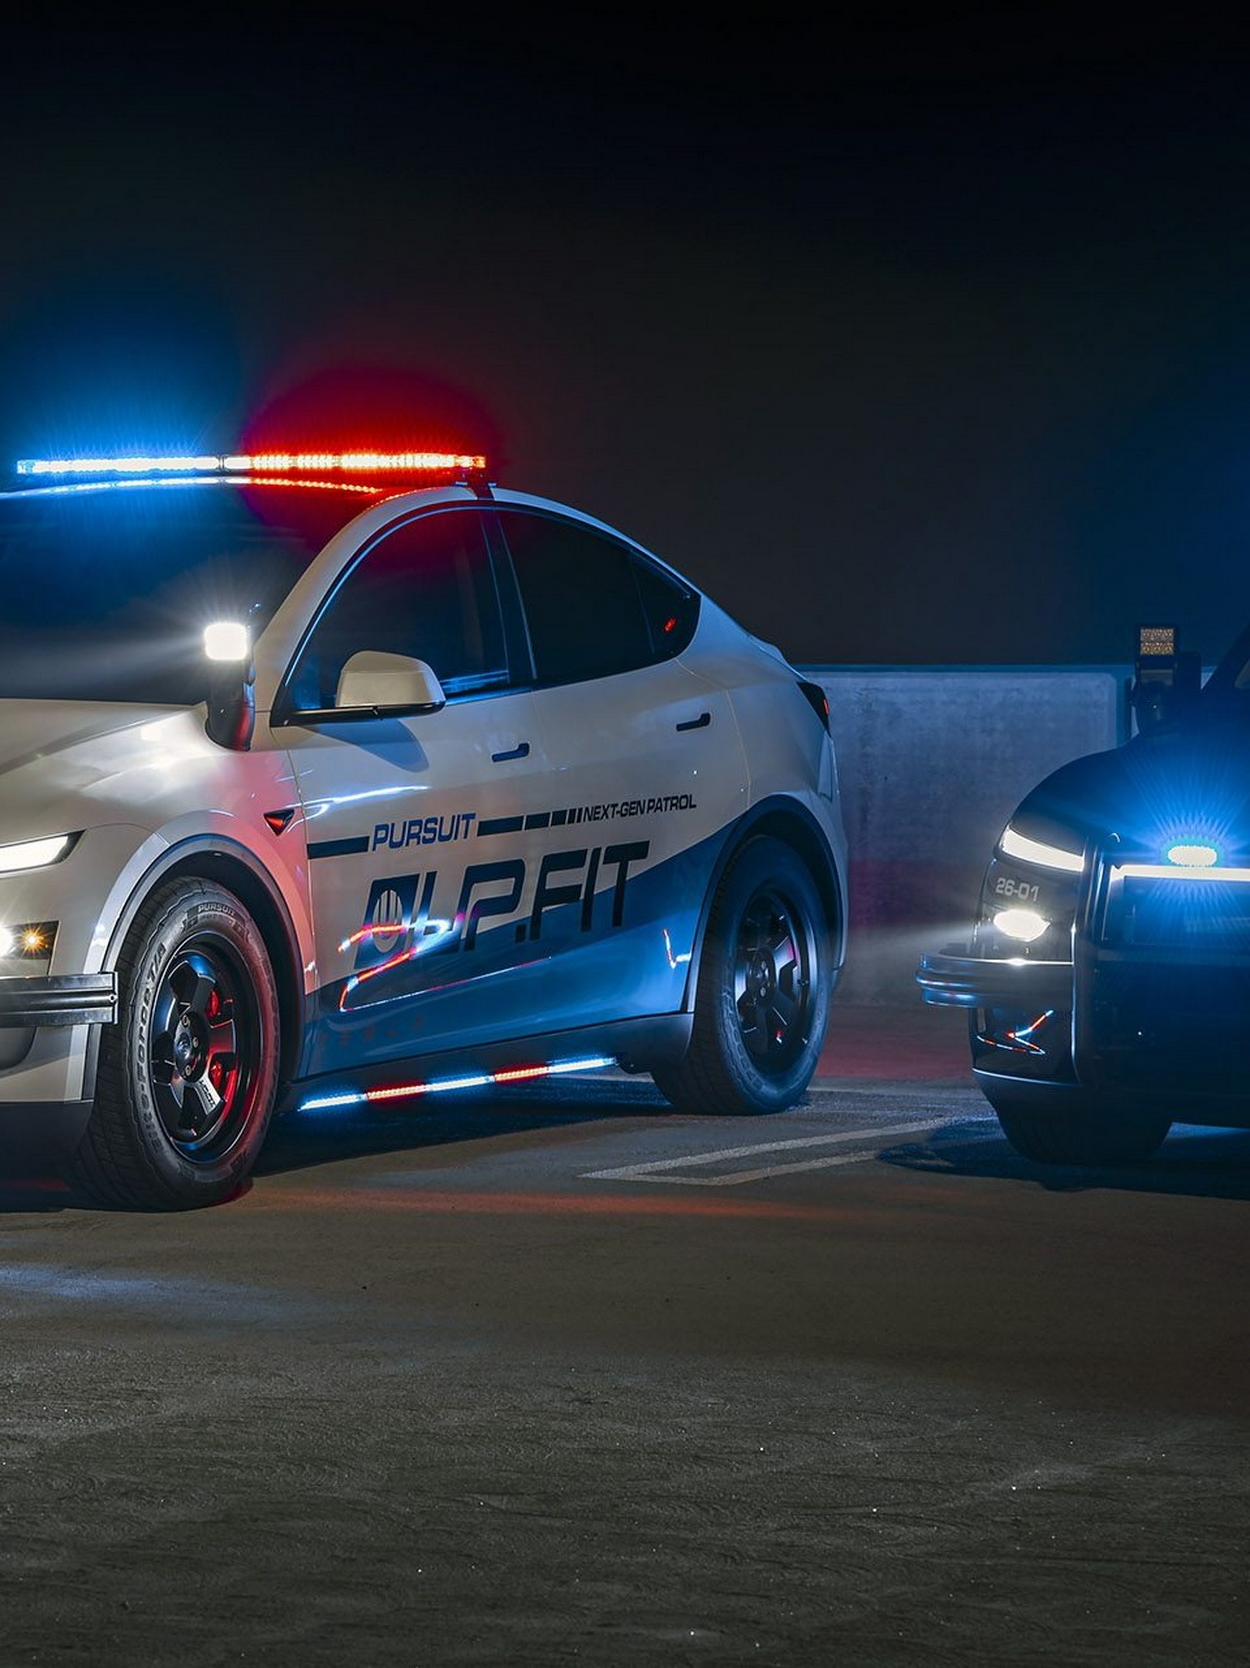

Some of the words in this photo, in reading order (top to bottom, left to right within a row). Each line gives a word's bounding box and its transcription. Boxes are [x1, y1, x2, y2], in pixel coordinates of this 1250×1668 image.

[583, 800, 646, 822] NEXT-GEN
[646, 794, 697, 814] PATROL
[372, 813, 476, 851] PURSUIT
[995, 877, 1040, 902] 26-01
